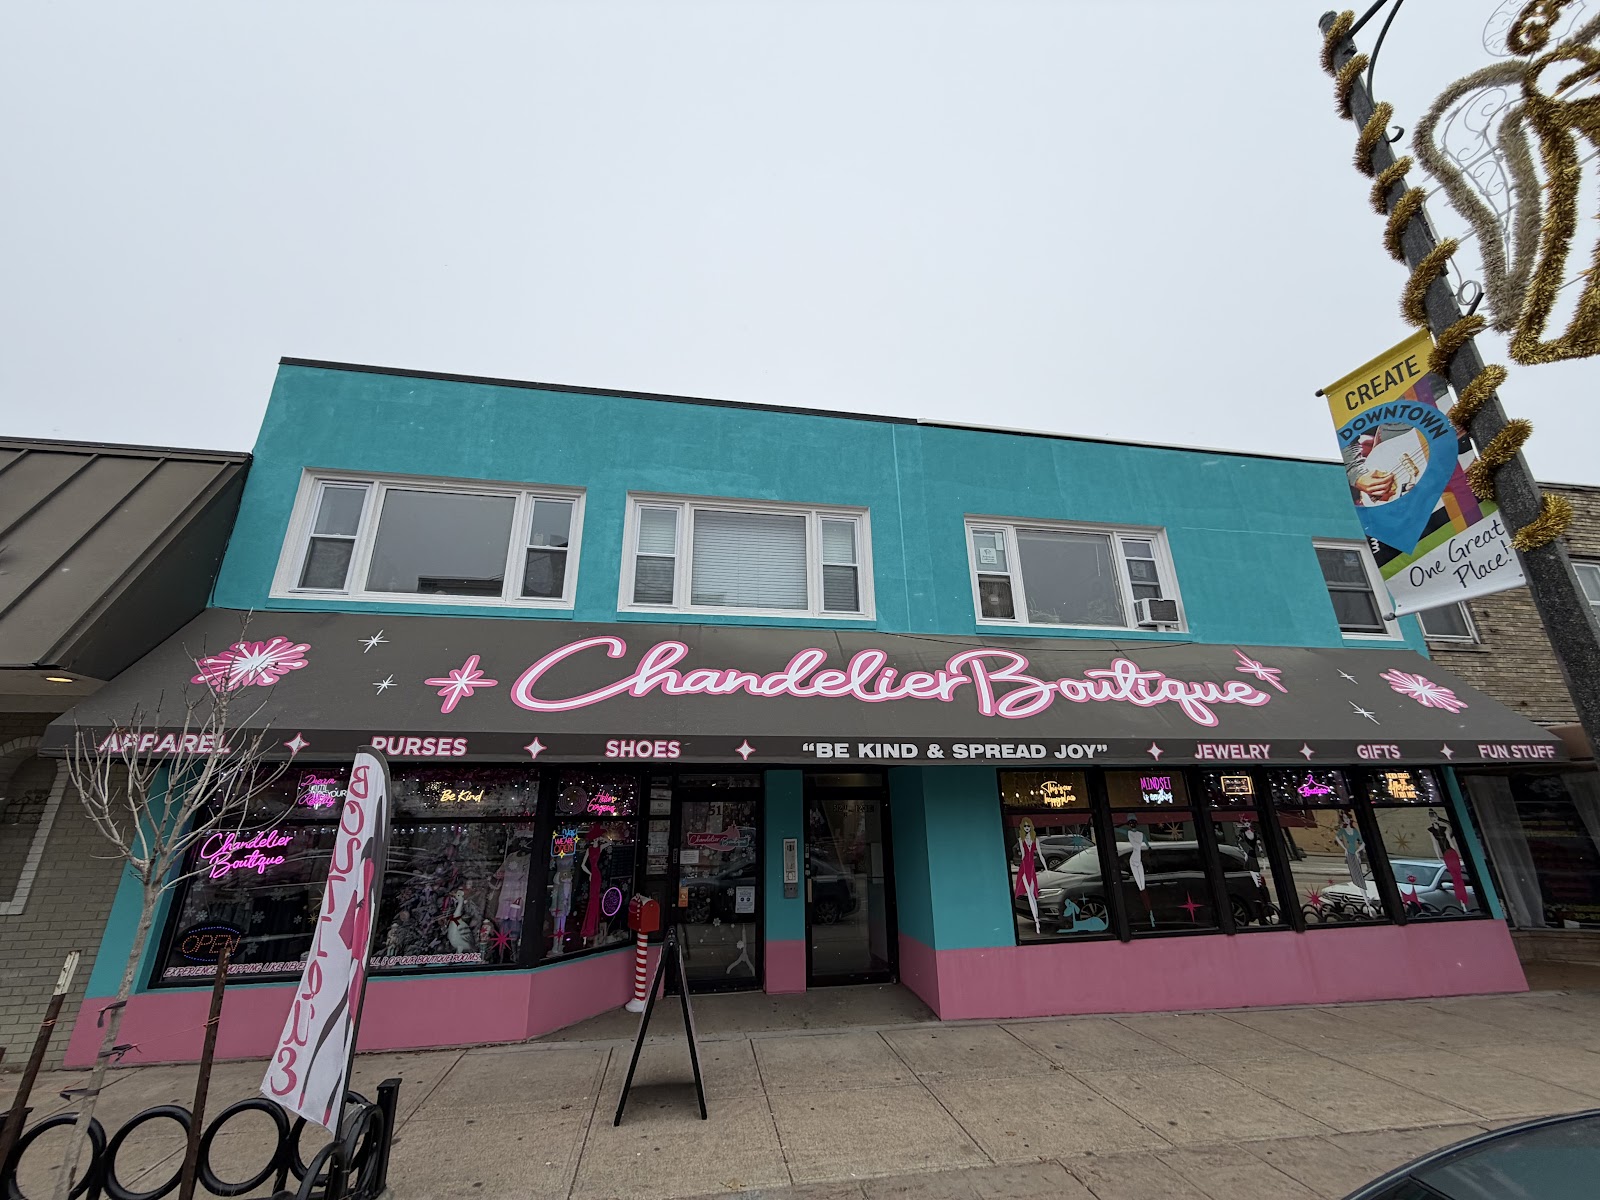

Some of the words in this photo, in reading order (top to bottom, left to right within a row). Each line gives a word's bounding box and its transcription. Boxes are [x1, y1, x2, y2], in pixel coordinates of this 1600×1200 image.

[1345, 354, 1420, 410] CREATE
[1339, 405, 1449, 440] DOWNTOWN
[1410, 560, 1446, 586] One
[1448, 519, 1505, 562] Great
[1453, 540, 1512, 588] Place!
[510, 636, 971, 712] Chandelier
[946, 648, 1271, 727] Boutique
[98, 733, 231, 754] APPAREL
[371, 736, 468, 756] PURSES
[604, 739, 681, 759] SHOES
[802, 743, 850, 758] “BE
[858, 743, 919, 758] KIND
[927, 743, 945, 758] &
[952, 743, 1047, 758] SPREAD
[1054, 743, 1108, 759] JOY”
[1194, 744, 1271, 760] JEWELRY
[1357, 744, 1400, 760] GIFTS
[1477, 744, 1510, 760] FUN
[1510, 744, 1555, 760] STUFF
[1140, 776, 1172, 791] MINDSET
[440, 789, 456, 801] Be
[457, 789, 484, 802] Kind
[201, 829, 293, 859] Chandelier
[553, 843, 574, 854] OPEN
[209, 849, 285, 879] Boutique
[182, 935, 242, 954] OPEN
[388, 956, 400, 966] OF
[400, 955, 417, 965] OUR
[416, 953, 452, 964] BOUTIQUE
[163, 964, 219, 978] EXPERIENCE
[262, 962, 284, 973] LIKE
[282, 961, 307, 972] NEVE
